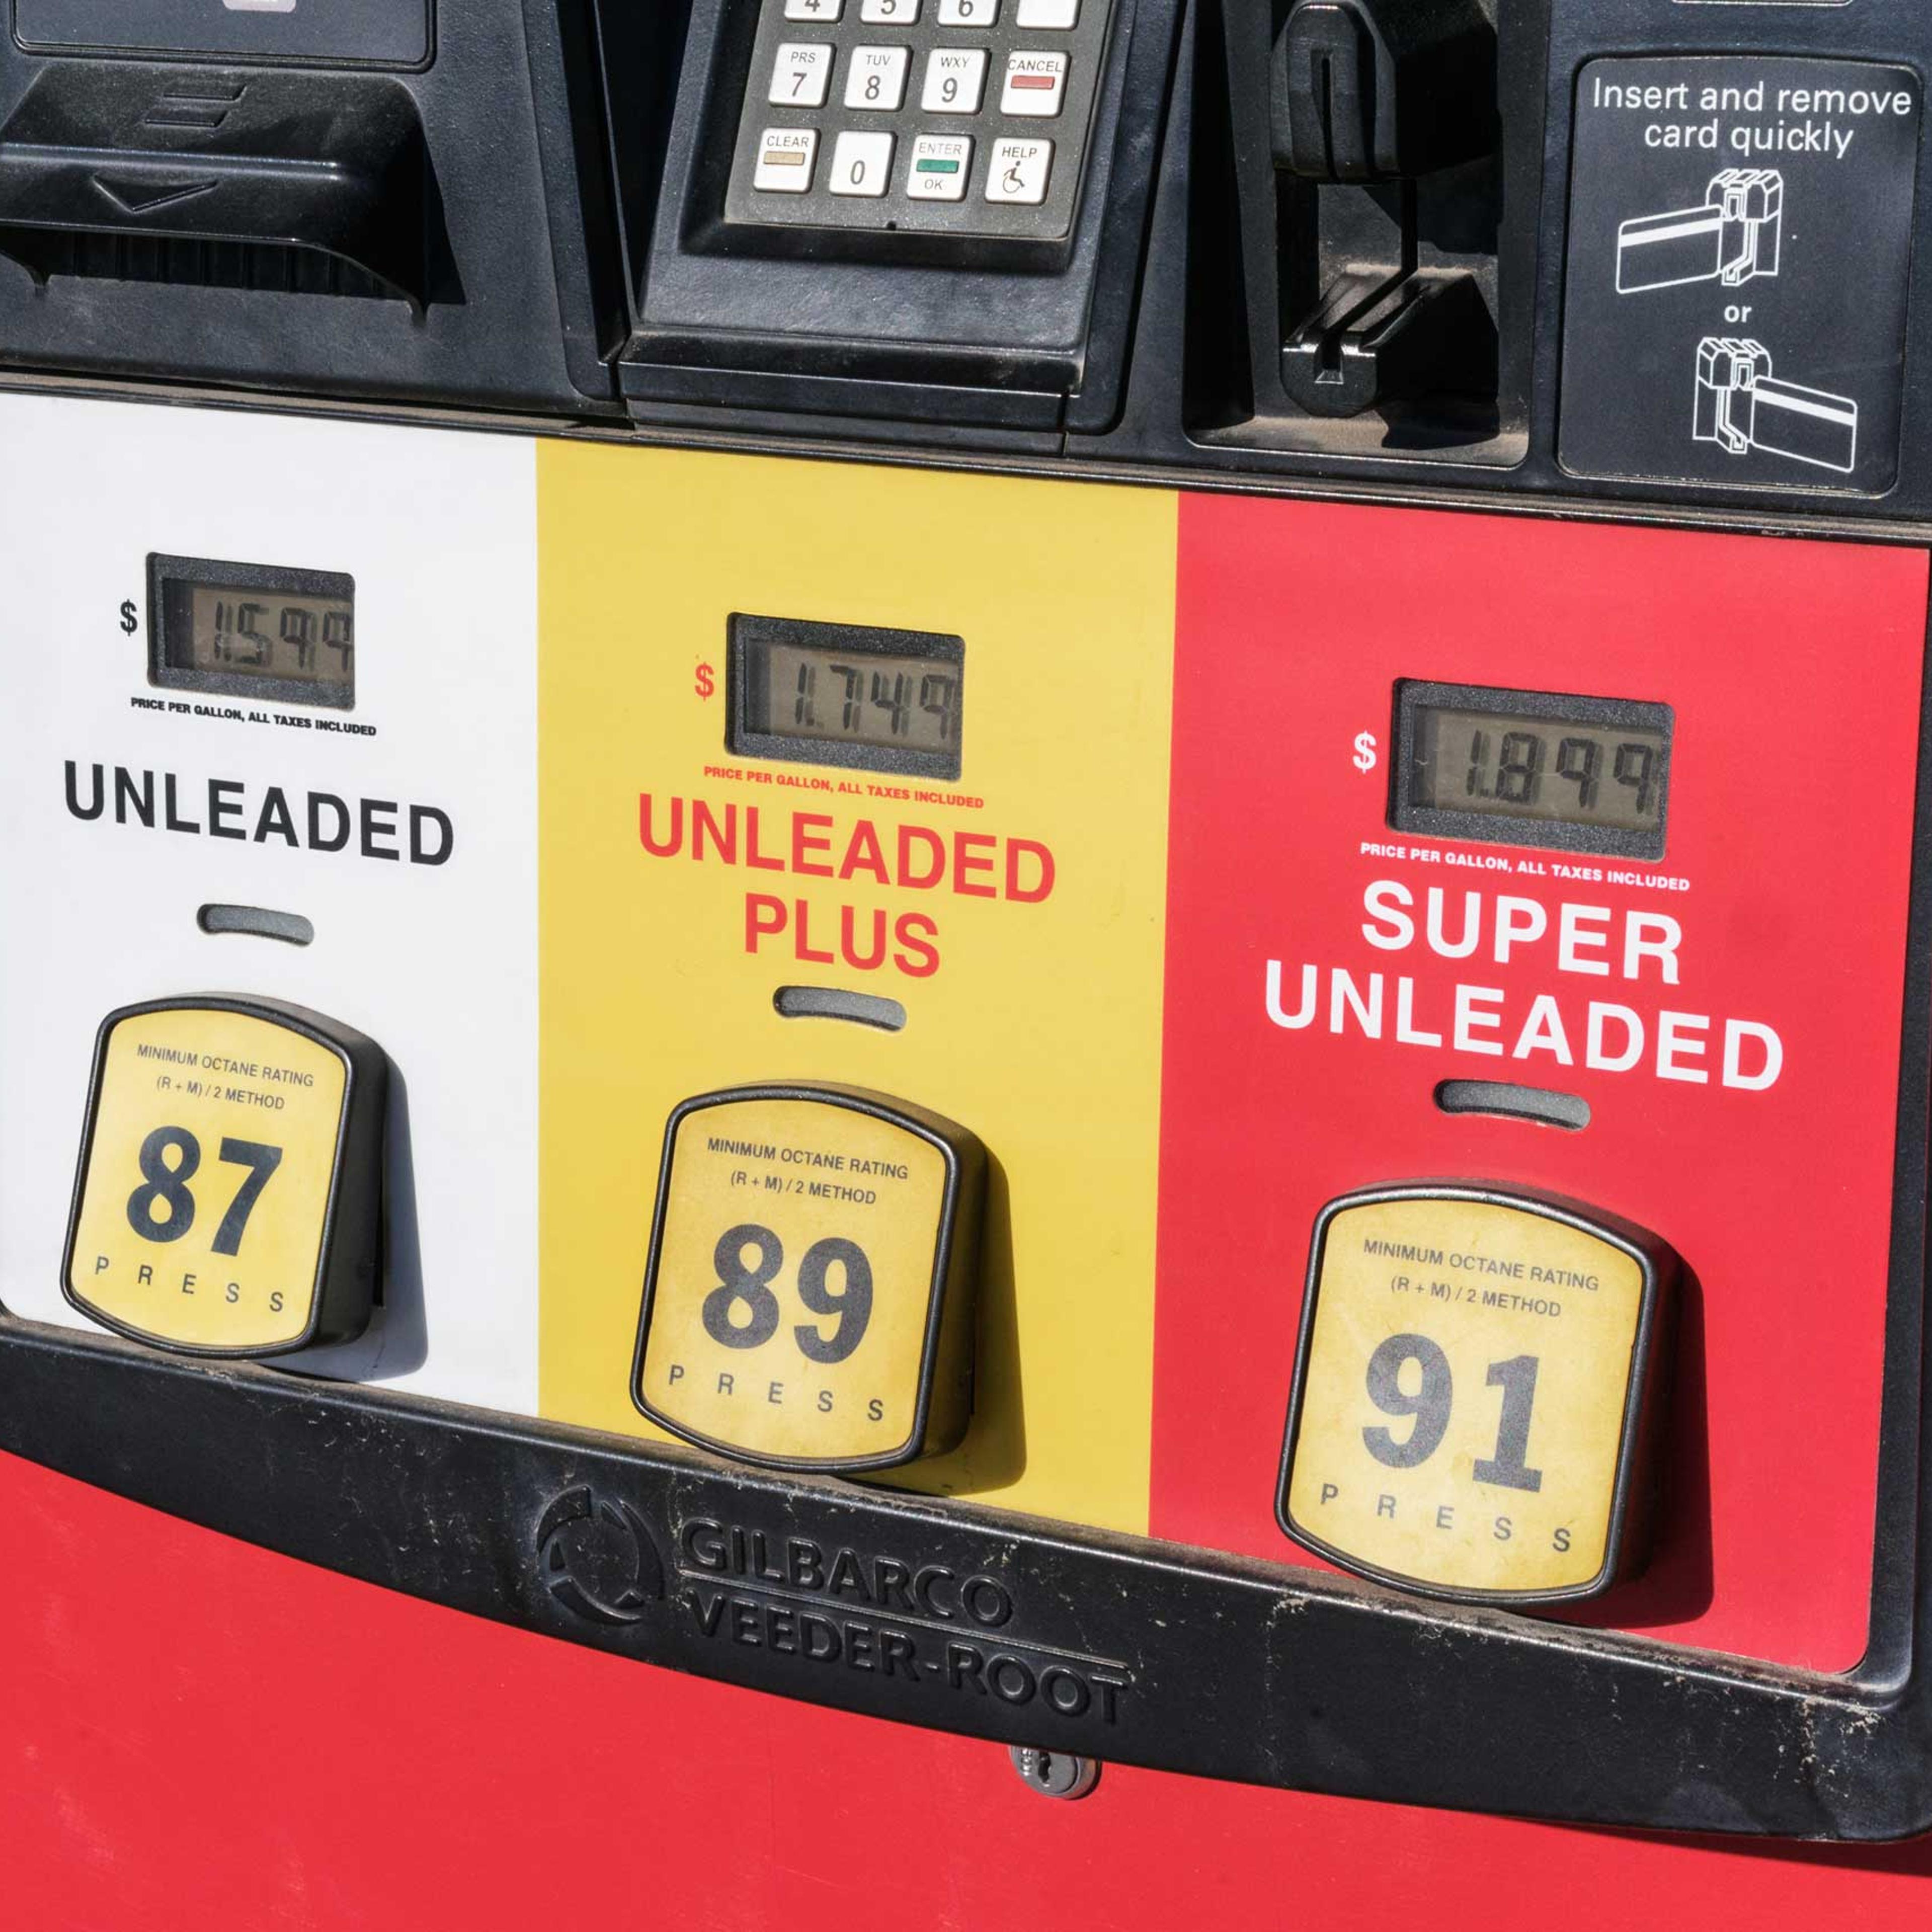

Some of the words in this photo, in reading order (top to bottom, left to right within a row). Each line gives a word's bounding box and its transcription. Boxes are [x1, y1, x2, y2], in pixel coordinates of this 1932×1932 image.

[957, 0, 974, 17] 6
[790, 52, 816, 63] PRS
[866, 54, 891, 65] TUV
[941, 57, 971, 68] WXY
[1008, 59, 1063, 72] CANCEL
[792, 72, 807, 97] 7
[865, 75, 880, 100] 8
[941, 77, 957, 103] 9
[1593, 77, 1688, 110] Insert
[1700, 81, 1764, 112] and
[1778, 87, 1912, 115] remove
[767, 135, 809, 147] CLEAR
[919, 142, 962, 154] ENTER
[1002, 146, 1037, 158] HELP
[1644, 119, 1718, 148] card
[1731, 120, 1854, 159] quickly
[850, 159, 865, 185] 0
[924, 179, 943, 190] OK
[1724, 305, 1752, 323] or
[120, 600, 138, 636] $
[694, 662, 714, 701] $
[131, 697, 165, 711] PRICE
[168, 702, 191, 713] PER
[194, 706, 245, 722] GALLON,
[249, 712, 270, 724] ALL
[274, 715, 311, 729] TAXES
[315, 720, 377, 736] INCLUDED
[1352, 731, 1377, 773] $
[704, 766, 743, 780] PRICE
[747, 771, 772, 784] PER
[776, 775, 834, 793] GALLON,
[838, 782, 862, 795] ALL
[866, 785, 910, 800] TAXES
[915, 791, 984, 809] INCLUDED
[64, 760, 454, 866] UNLEADED
[639, 792, 1056, 904] UNLEADED
[1360, 842, 1406, 859] PRICE
[1410, 848, 1440, 863] PER
[1445, 852, 1512, 873] GALLON,
[1517, 861, 1547, 875] ALL
[1551, 864, 1602, 881] TAXES
[1607, 870, 1691, 892] INCLUDED
[745, 892, 939, 978] PLUS
[1361, 879, 1682, 985] SUPER
[1264, 959, 1784, 1091] UNLEADED
[136, 1043, 198, 1067] MINIMUM
[202, 1056, 258, 1077] OCTANE
[262, 1067, 314, 1087] RATING
[213, 1086, 222, 1099] 2
[225, 1088, 285, 1110] METHOD
[707, 1137, 776, 1160] MINIMUM
[781, 1148, 844, 1170] OCTANE
[850, 1158, 909, 1180] RATING
[126, 1125, 283, 1257] 87
[795, 1180, 804, 1194] 2
[809, 1182, 876, 1205] METHOD
[95, 1256, 283, 1313] PRESS
[1363, 1239, 1443, 1266] MINIMUM
[1449, 1253, 1523, 1279] OCTANE
[1530, 1266, 1599, 1292] RATING
[701, 1224, 873, 1364] 89
[1467, 1288, 1477, 1304] 2
[1482, 1291, 1562, 1317] METHOD
[669, 1364, 883, 1422] PRESS
[1361, 1333, 1544, 1494] 91
[1320, 1483, 1571, 1553] PRESS
[679, 1517, 1015, 1627] GILBARCO
[686, 1588, 1130, 1724] VEEDER-ROOT
